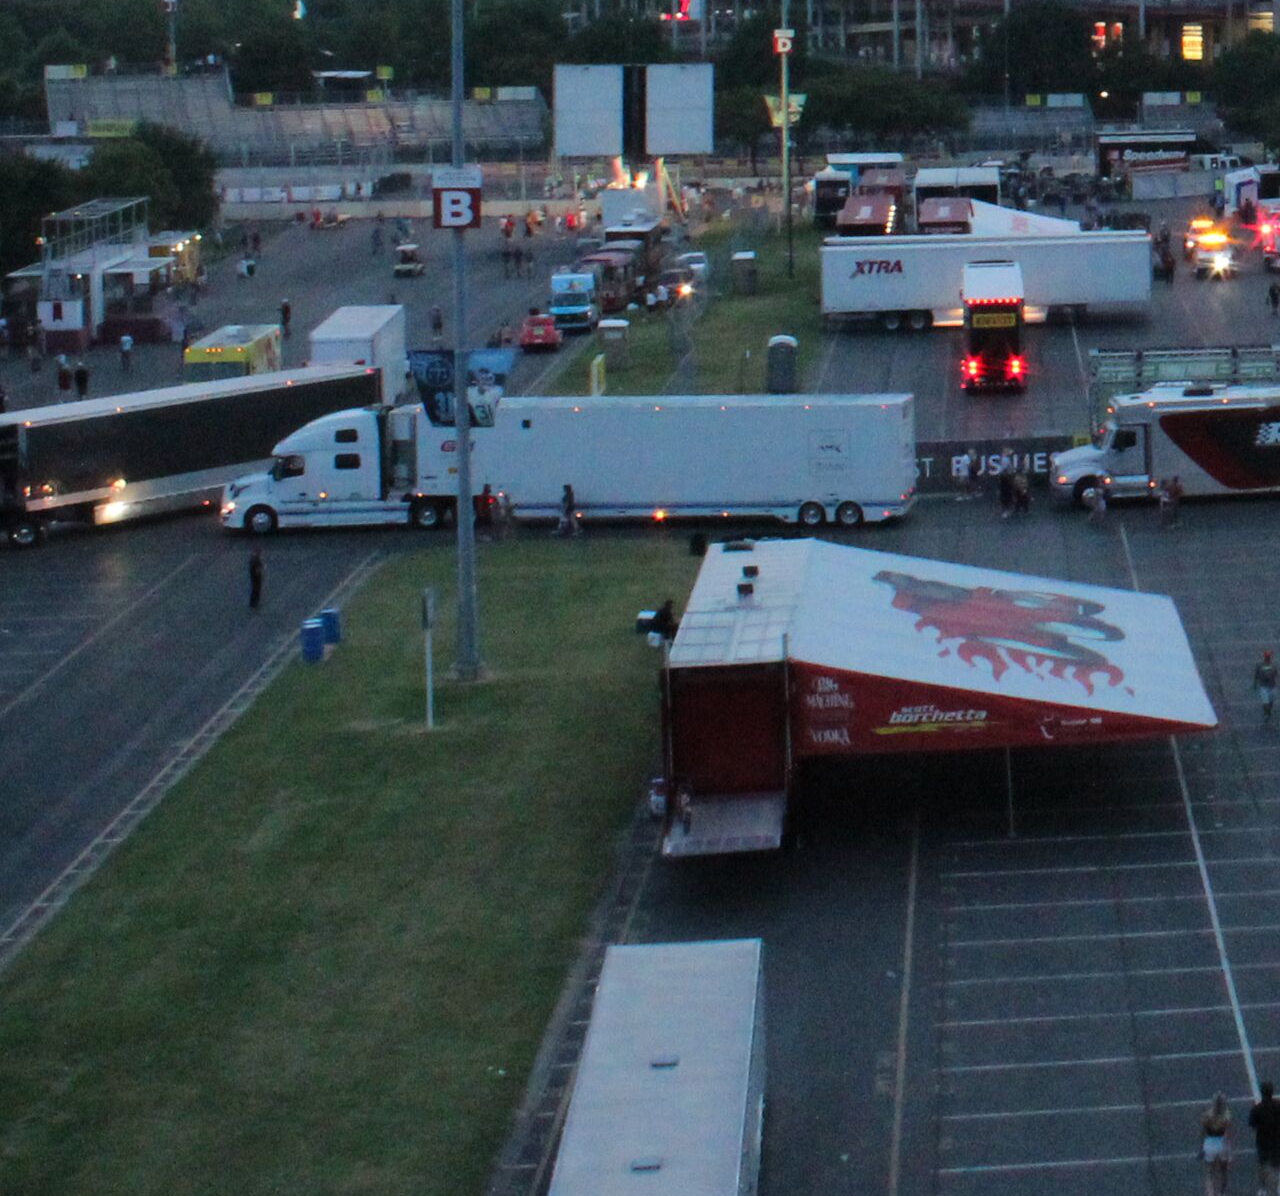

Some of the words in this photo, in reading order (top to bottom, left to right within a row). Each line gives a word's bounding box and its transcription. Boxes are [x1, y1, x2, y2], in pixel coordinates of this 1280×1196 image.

[440, 190, 474, 227] B
[851, 260, 903, 279] XTRA
[888, 708, 988, 725] borchetta
